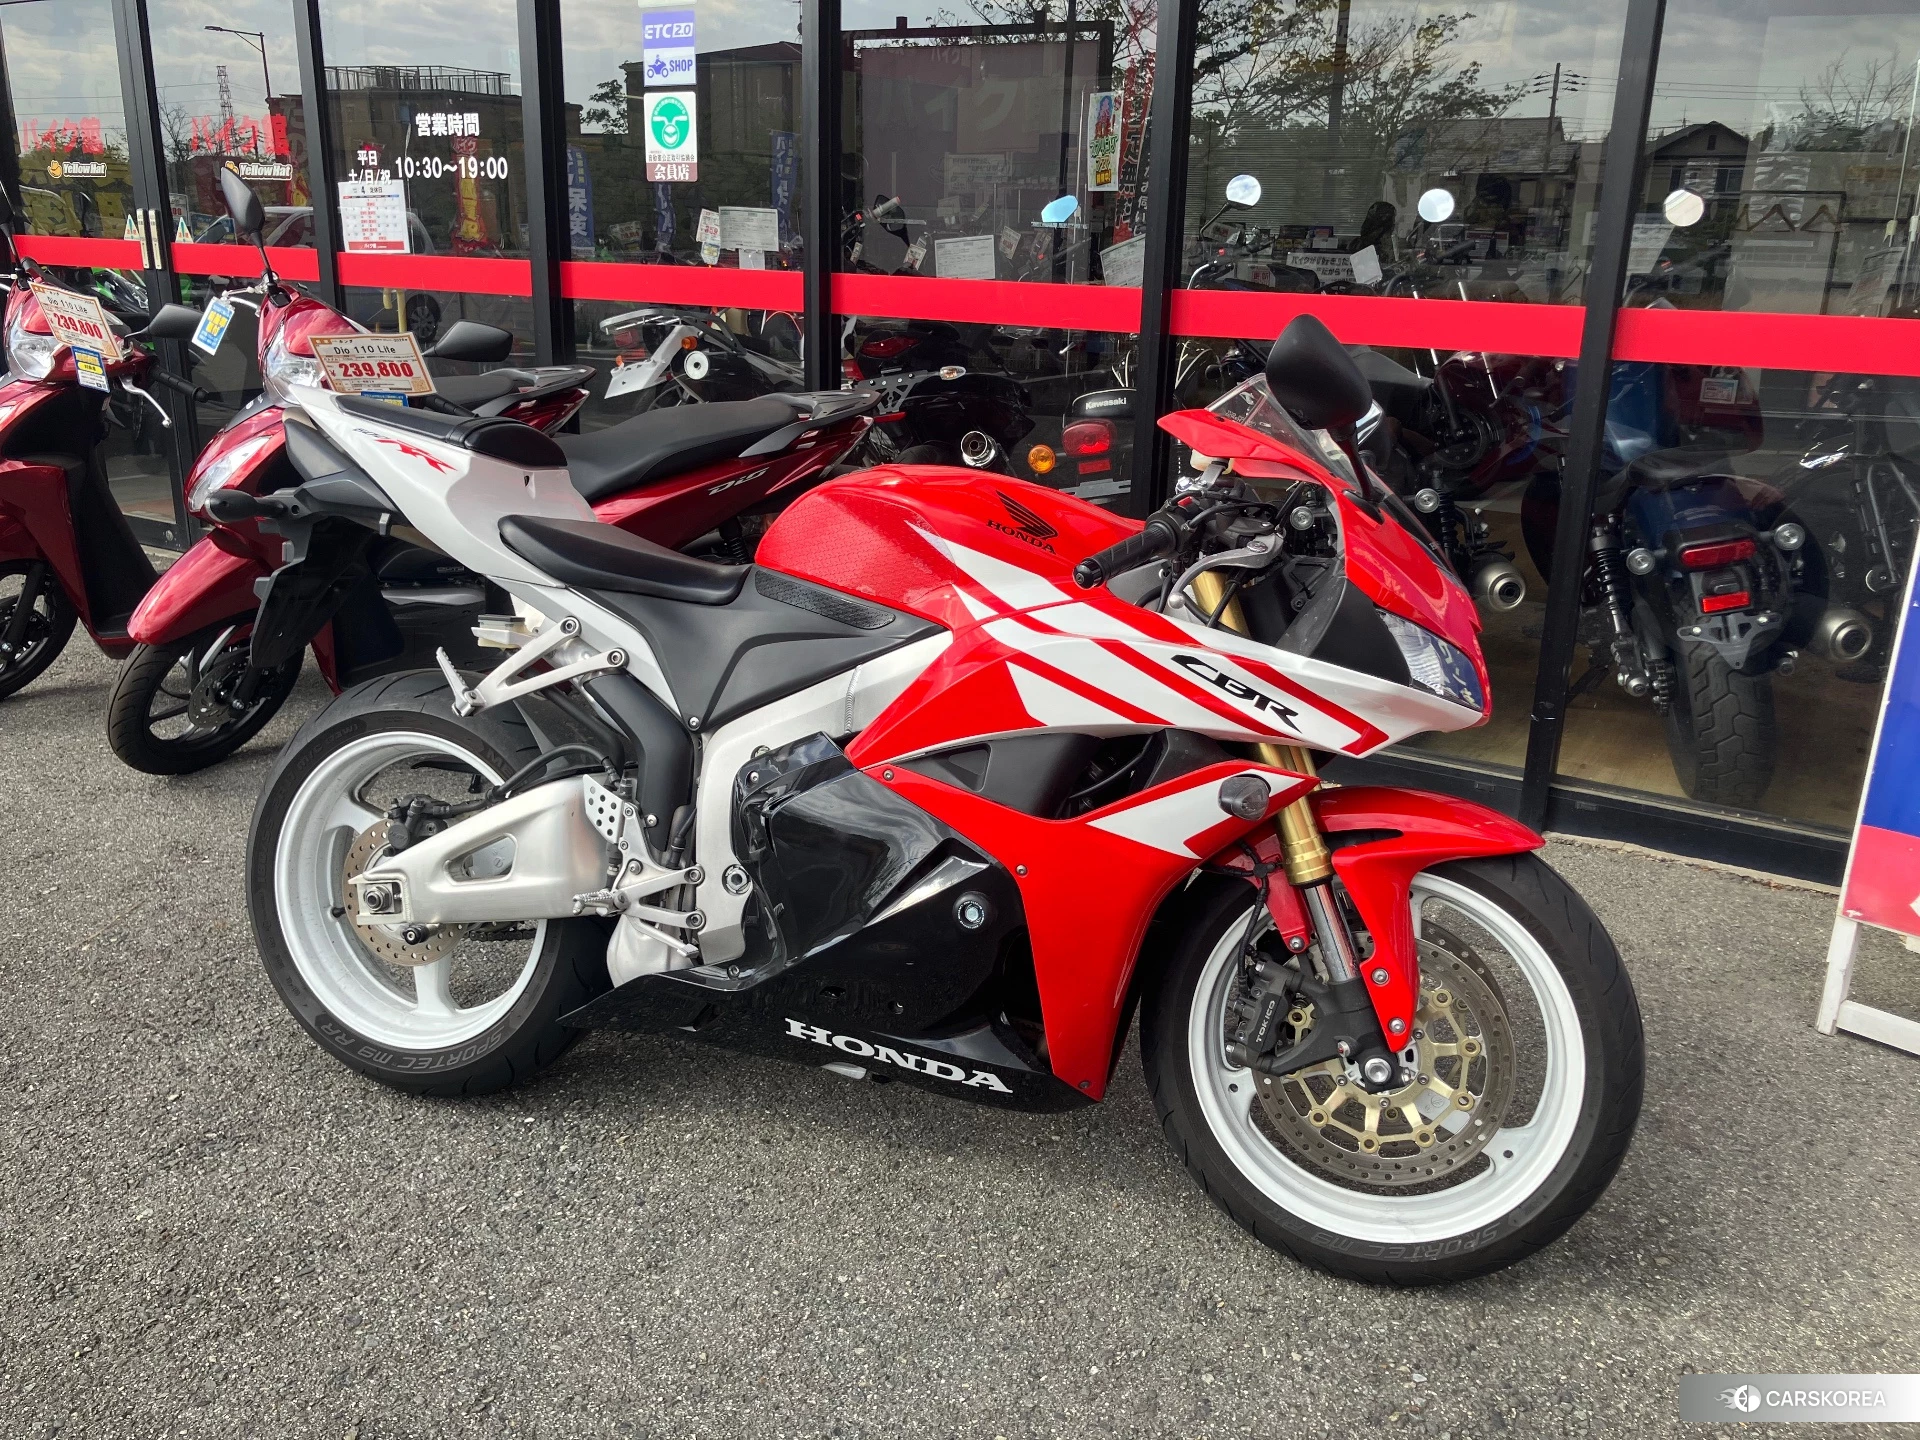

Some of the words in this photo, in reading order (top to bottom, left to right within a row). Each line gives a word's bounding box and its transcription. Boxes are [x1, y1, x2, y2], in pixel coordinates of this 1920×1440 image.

[644, 23, 672, 39] ETC
[673, 23, 693, 37] 2.0
[669, 59, 693, 72] SHOP
[415, 112, 480, 137] 営業時間
[356, 150, 378, 166] 平日
[349, 169, 392, 186] 土/日/祝
[654, 163, 690, 181] 会員店
[53, 312, 103, 340] 239,800
[333, 346, 350, 355] Dio
[354, 345, 375, 354] 110
[377, 345, 396, 354] Lite
[338, 361, 414, 379] 239,800
[1085, 397, 1127, 410] Kawasaki
[986, 519, 1057, 555] HONDA
[1170, 654, 1303, 735] CBR
[1255, 1000, 1276, 1043] TOKICO
[320, 1022, 356, 1047] RR
[399, 1024, 505, 1070] SPORTEC
[785, 1018, 1014, 1094] HONDA
[1363, 1222, 1501, 1261] SPORTEC
